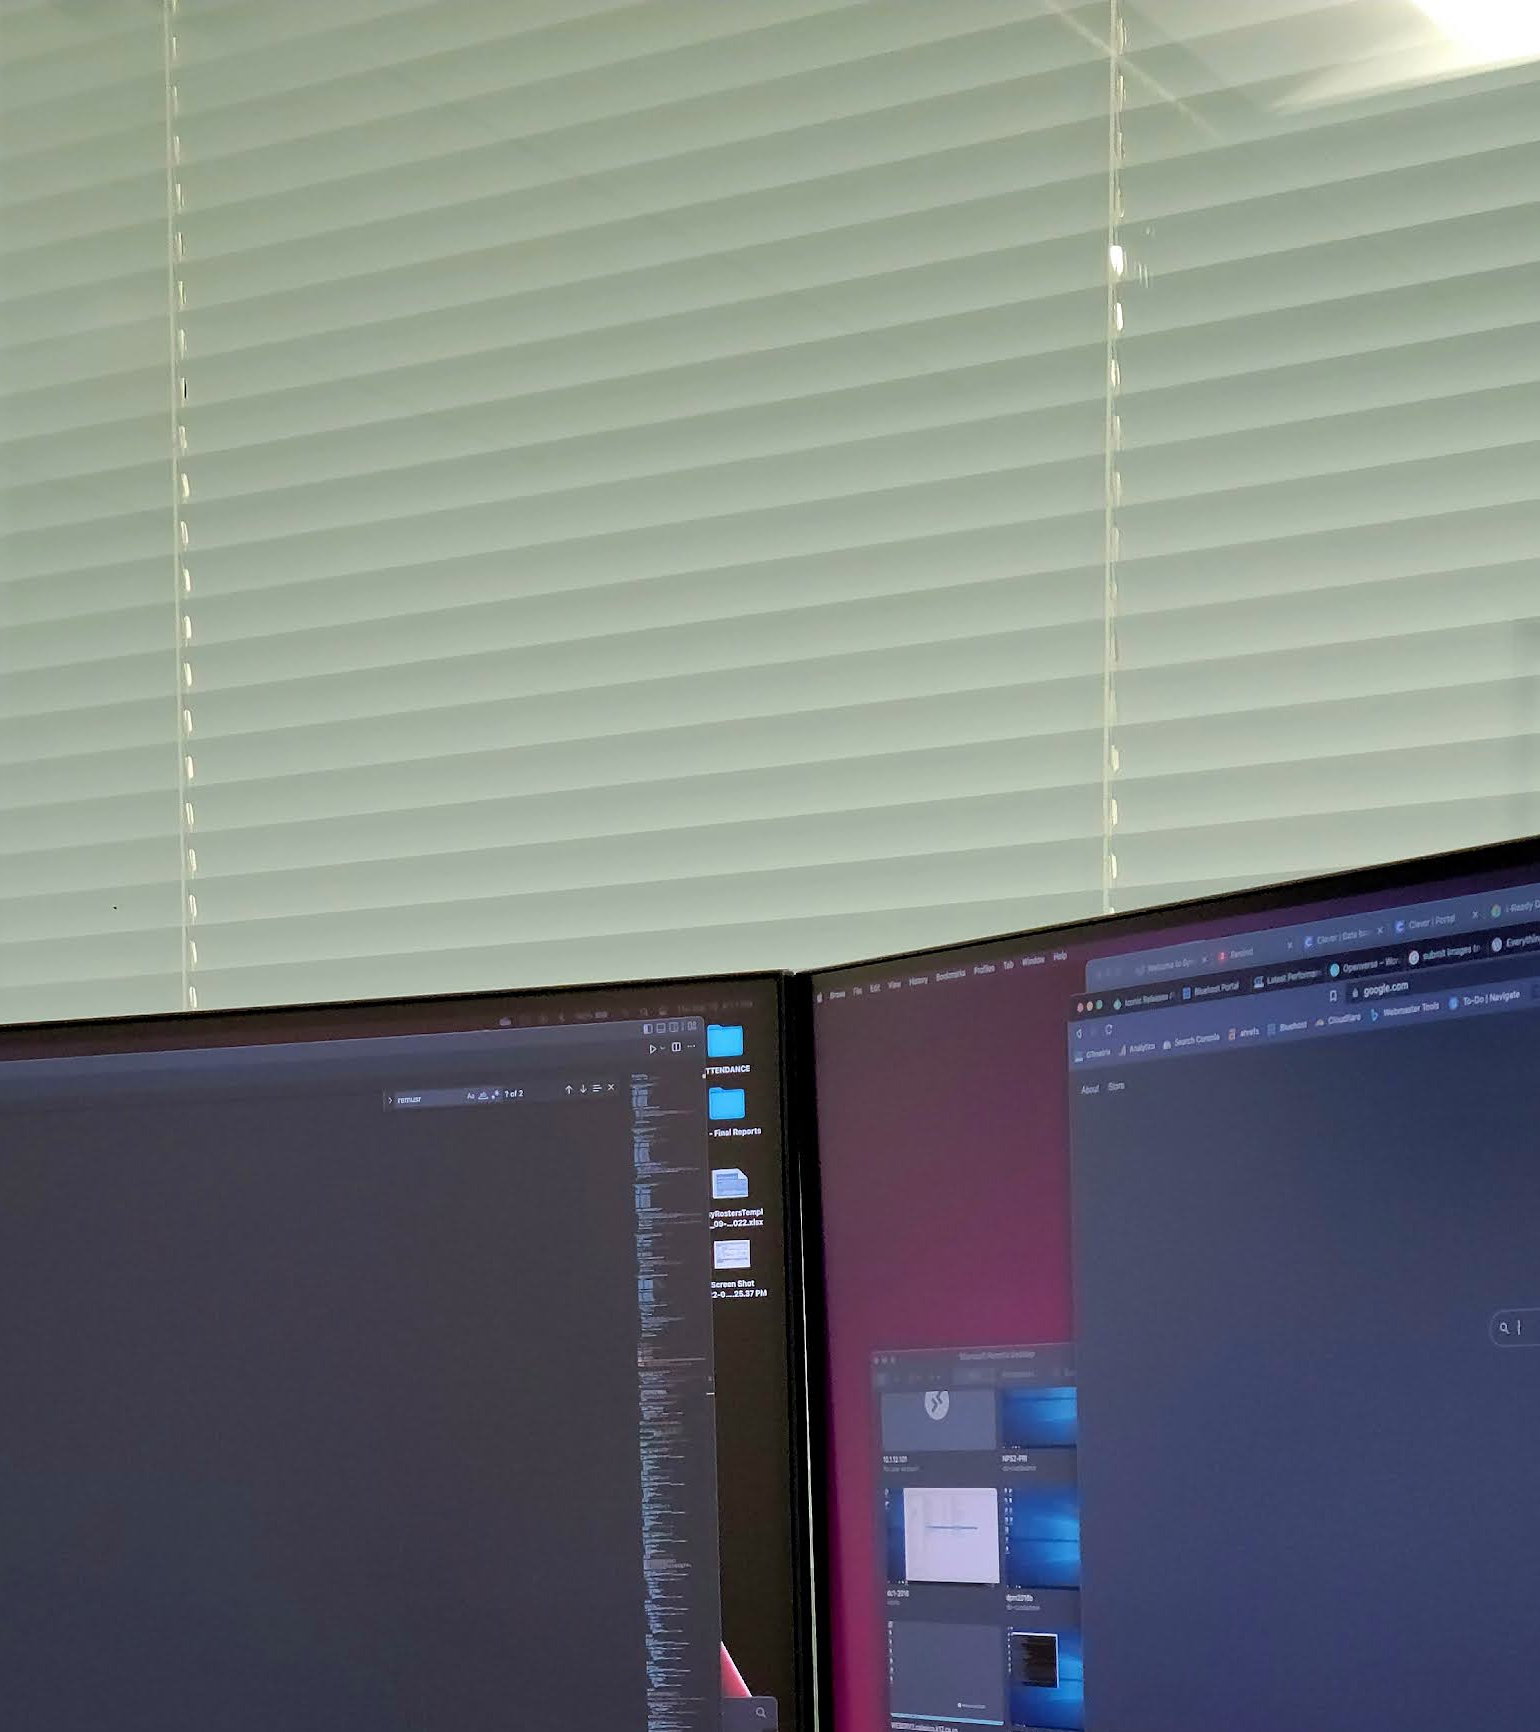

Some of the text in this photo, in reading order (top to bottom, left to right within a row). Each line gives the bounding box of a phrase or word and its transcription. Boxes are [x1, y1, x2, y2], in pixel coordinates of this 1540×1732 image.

[1363, 981, 1409, 997] google.com
[702, 1065, 751, 1079] TTENDANCE
[714, 1127, 762, 1137] Final Reports
[737, 1280, 755, 1288] Shot
[755, 1289, 768, 1297] PM
